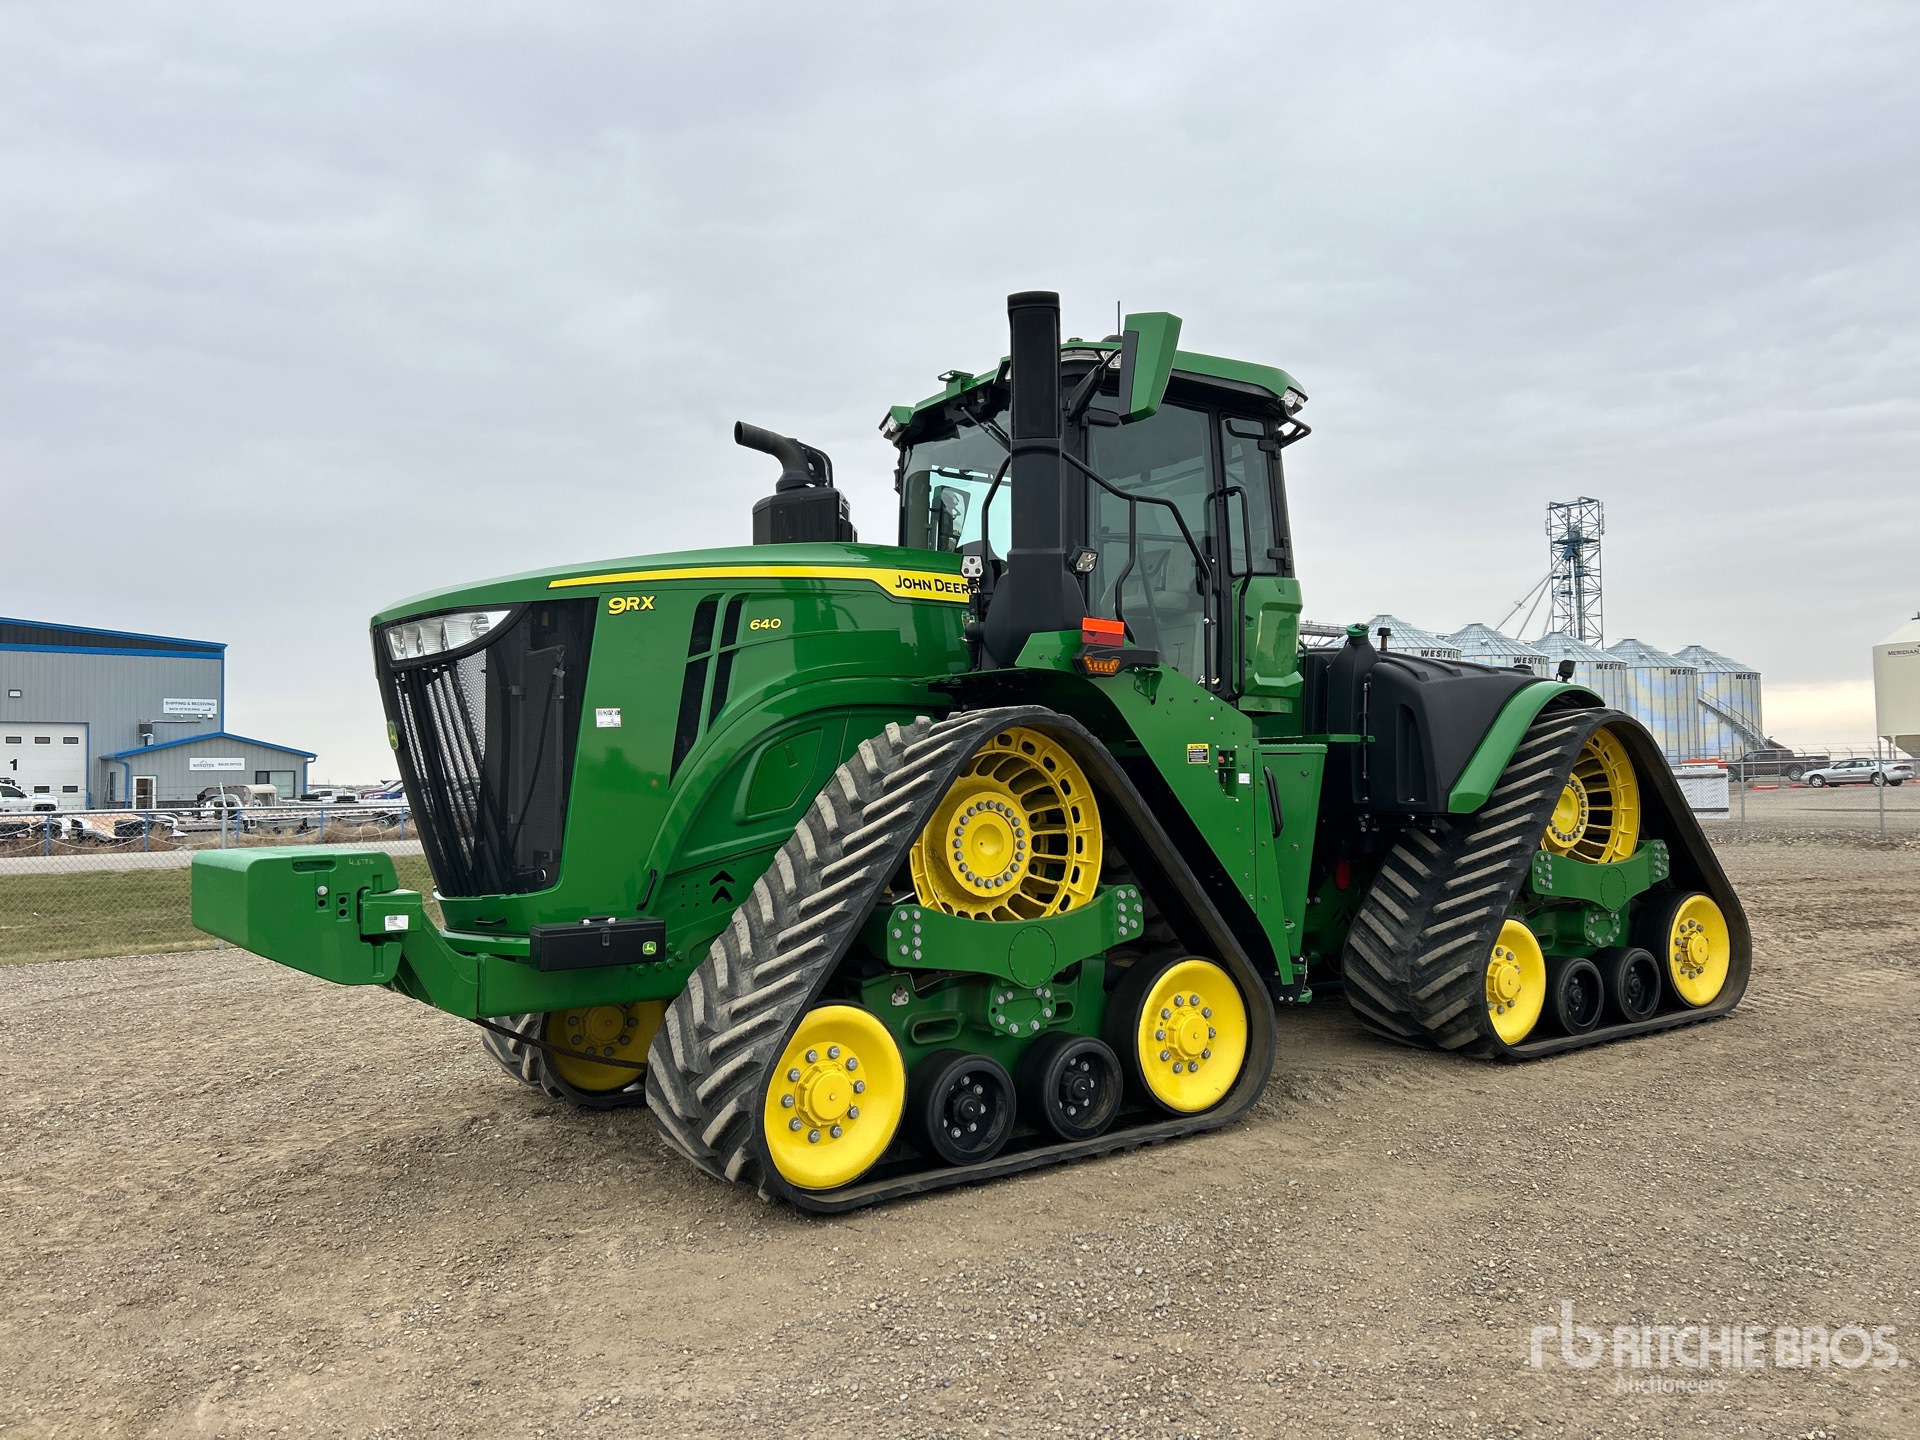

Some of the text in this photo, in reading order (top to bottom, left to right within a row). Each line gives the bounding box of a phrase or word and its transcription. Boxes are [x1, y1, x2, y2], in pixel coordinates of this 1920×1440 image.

[895, 575, 932, 591] JOHN
[608, 595, 656, 615] 9RX
[749, 618, 782, 630] 640
[1595, 662, 1625, 671] WESTE
[10, 758, 18, 771] 1
